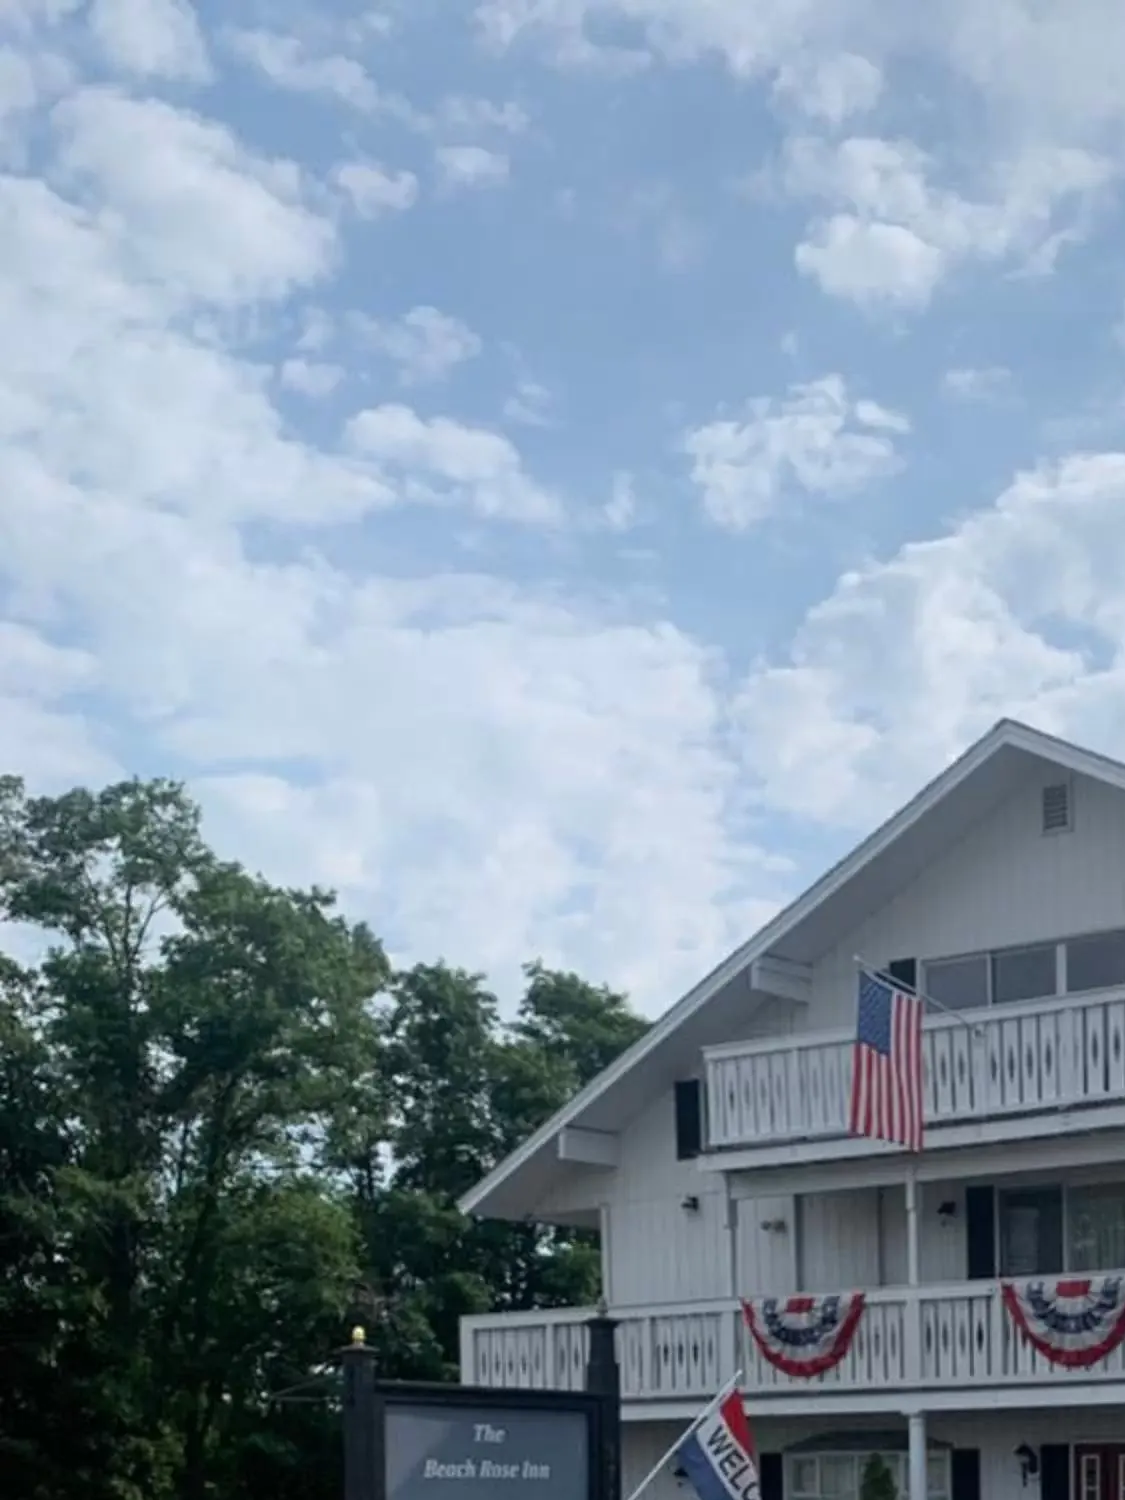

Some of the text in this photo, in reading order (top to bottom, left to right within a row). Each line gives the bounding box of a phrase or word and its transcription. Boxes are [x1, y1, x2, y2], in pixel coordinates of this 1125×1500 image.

[473, 1423, 506, 1443] The
[424, 1459, 551, 1479] Beach Rose Inn
